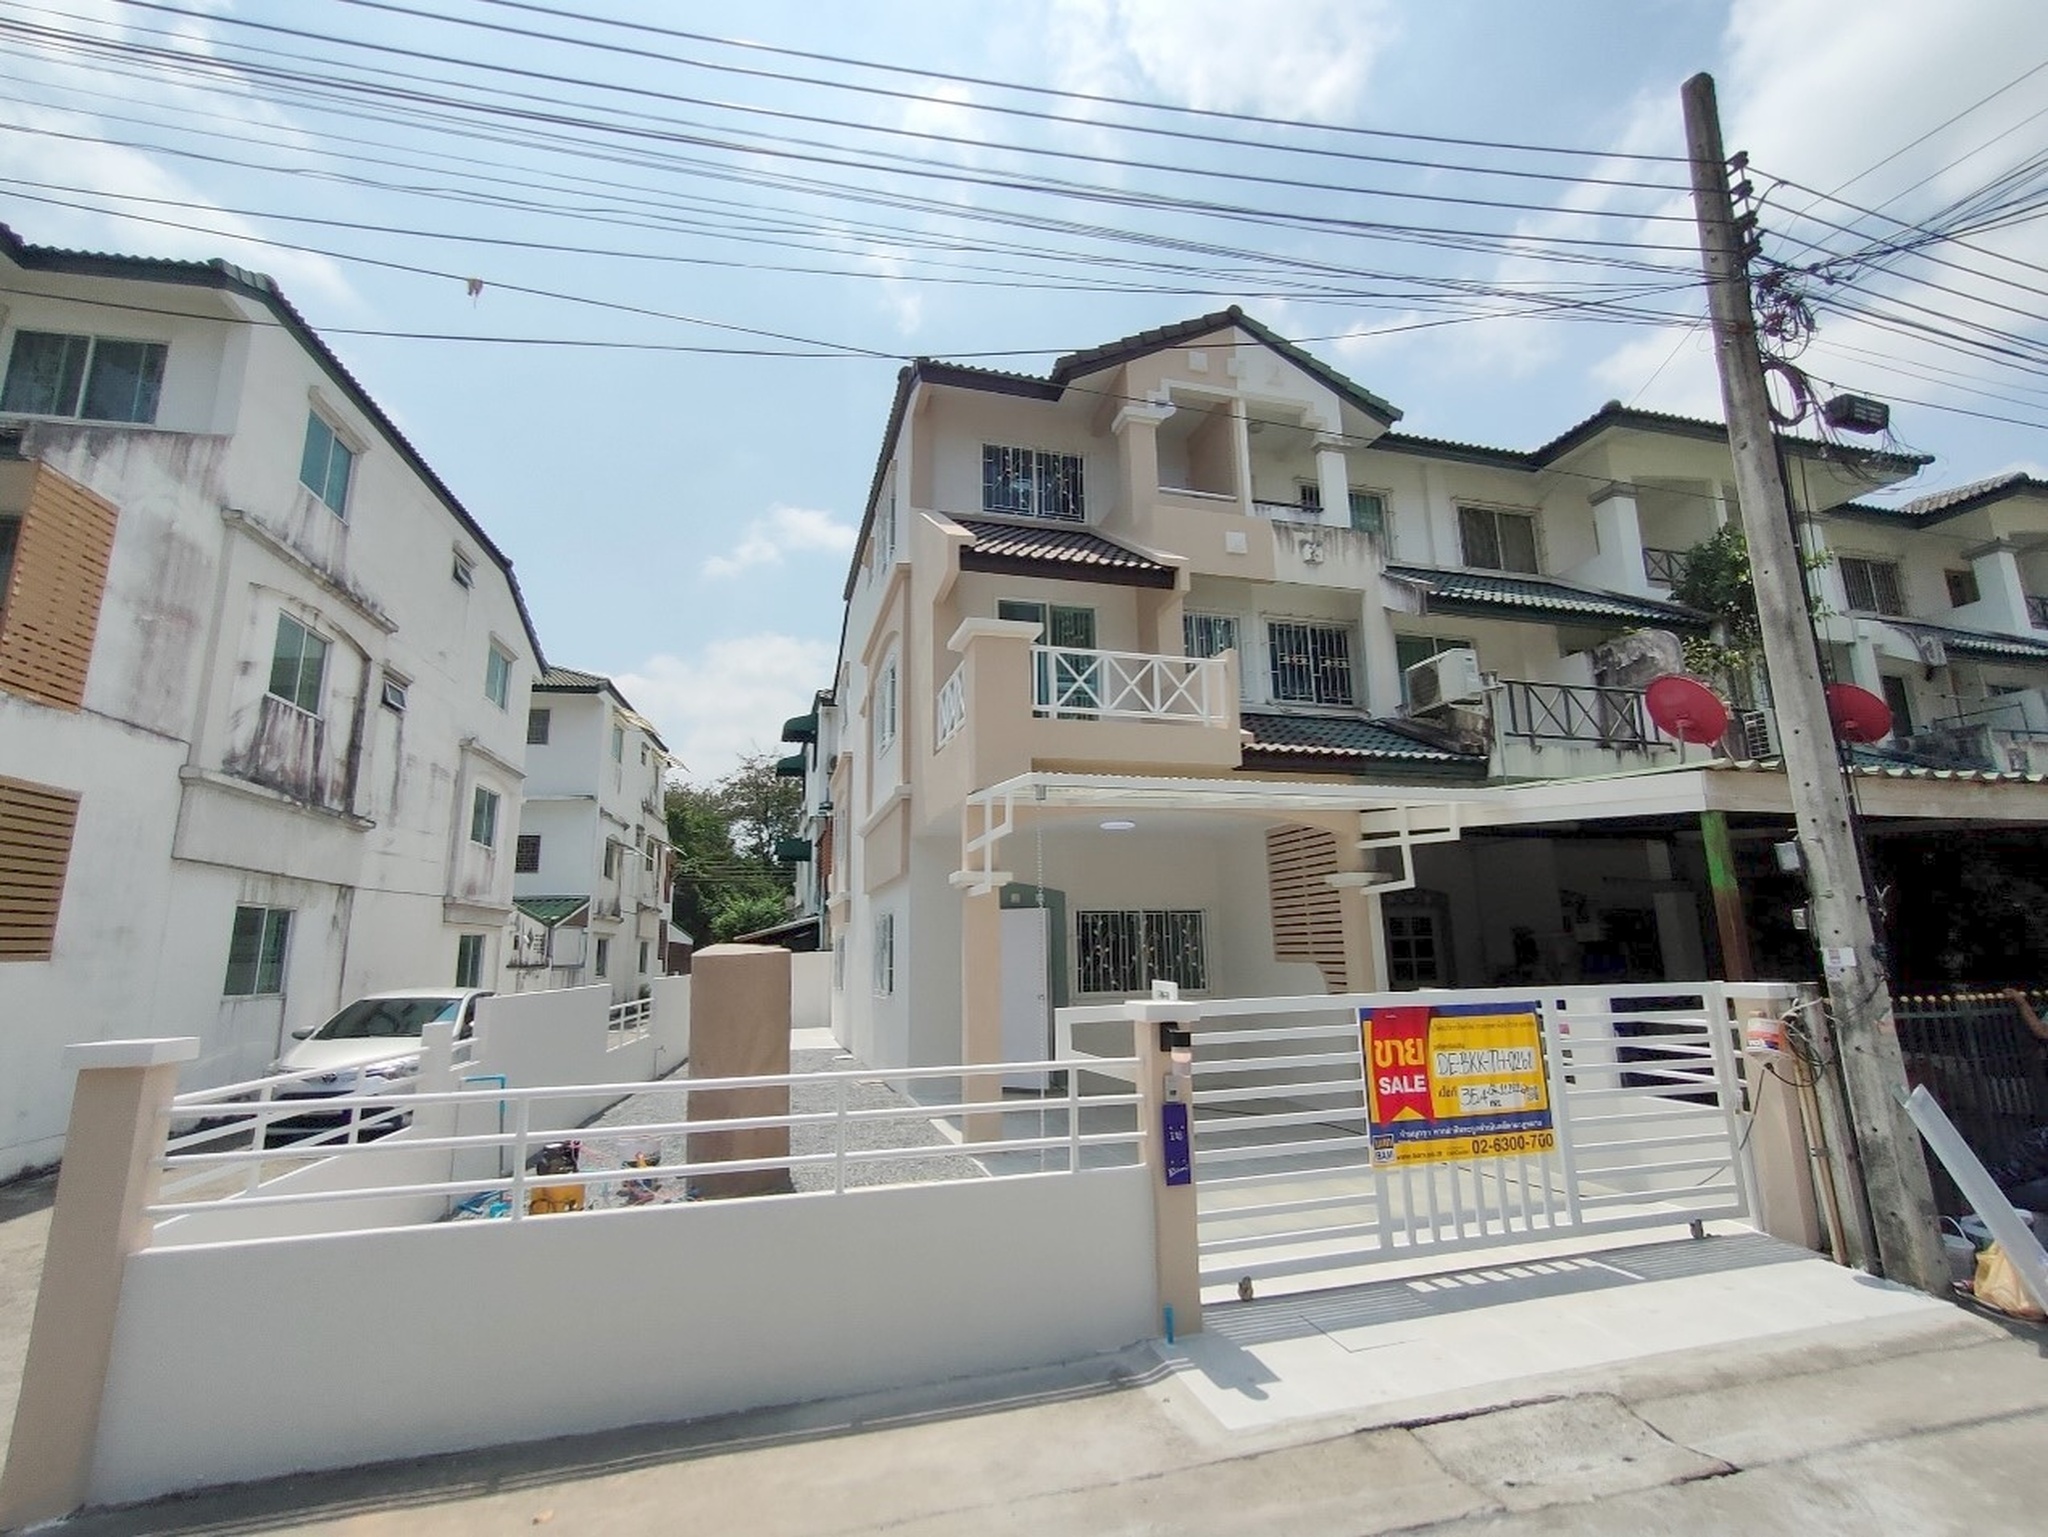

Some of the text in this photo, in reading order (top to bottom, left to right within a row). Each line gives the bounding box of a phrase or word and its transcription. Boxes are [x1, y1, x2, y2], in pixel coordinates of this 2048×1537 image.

[1374, 1038, 1425, 1068] ขาย
[1378, 1075, 1427, 1096] SALE
[1471, 1133, 1554, 1154] 02-6300-700
